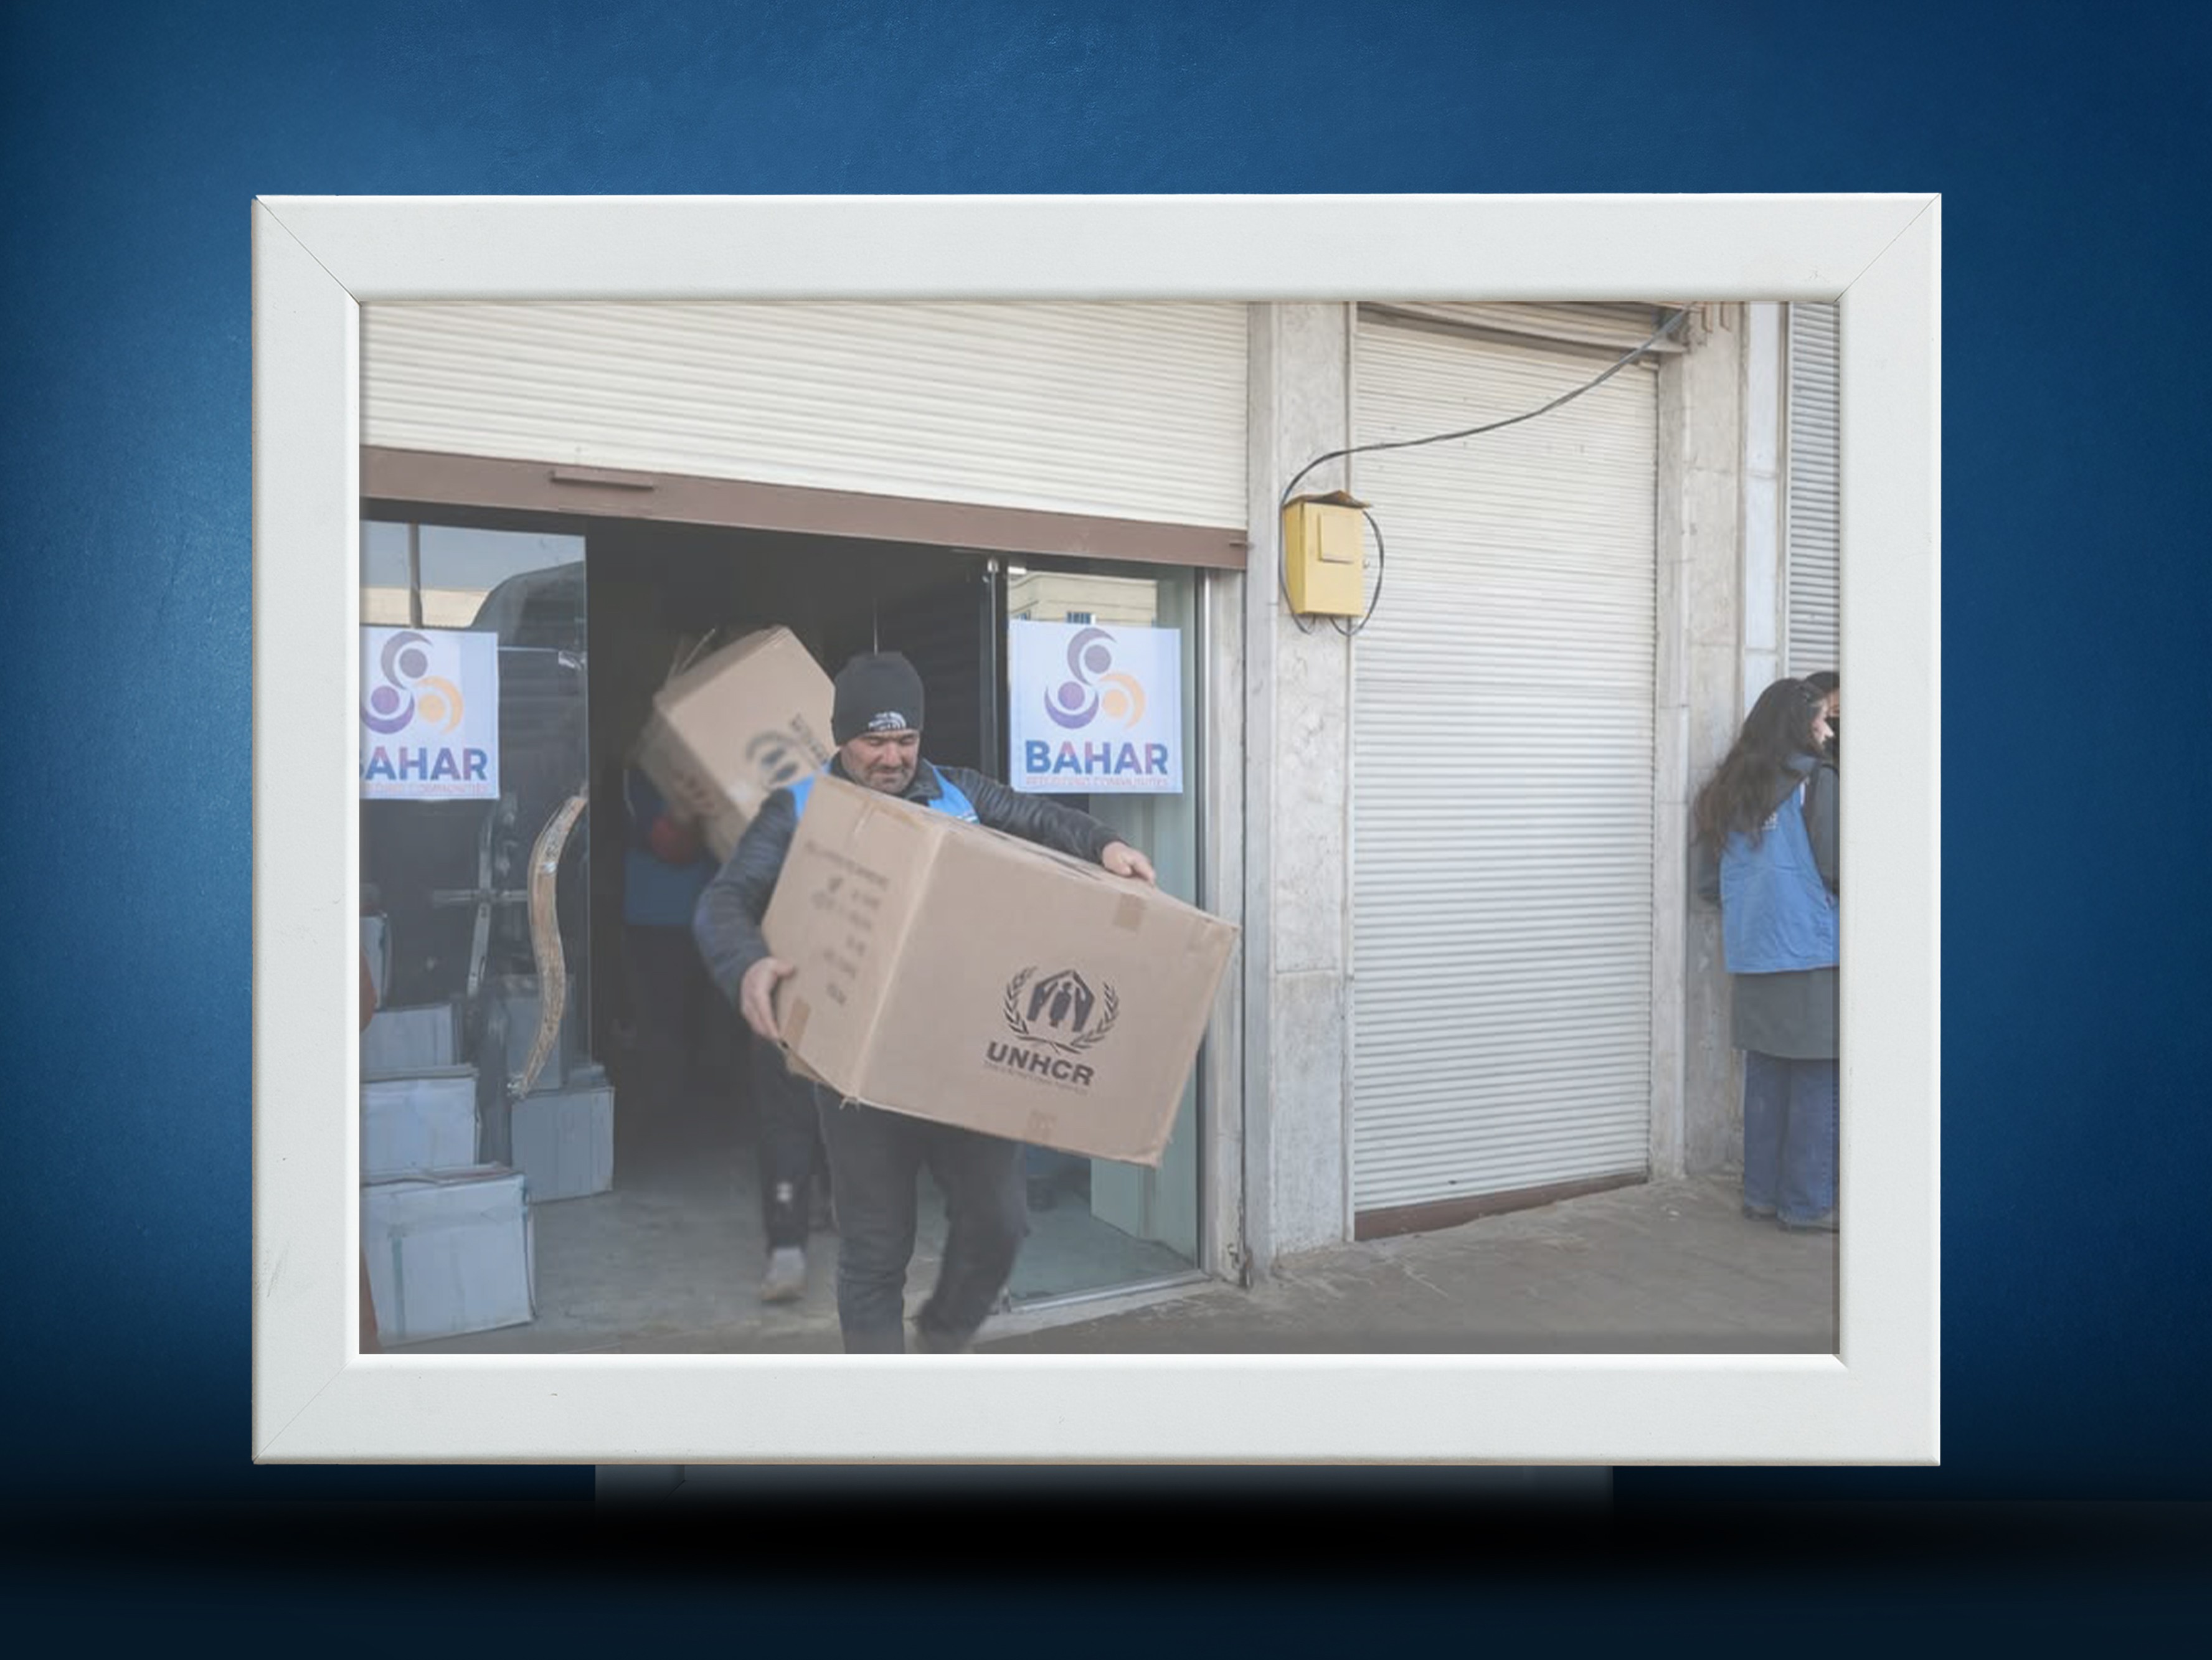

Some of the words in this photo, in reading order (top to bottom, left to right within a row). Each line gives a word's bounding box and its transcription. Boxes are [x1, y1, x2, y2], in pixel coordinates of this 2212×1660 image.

[359, 745, 488, 781] AHAR
[1025, 740, 1168, 775] BAHAR
[986, 1040, 1094, 1086] UNHCR
